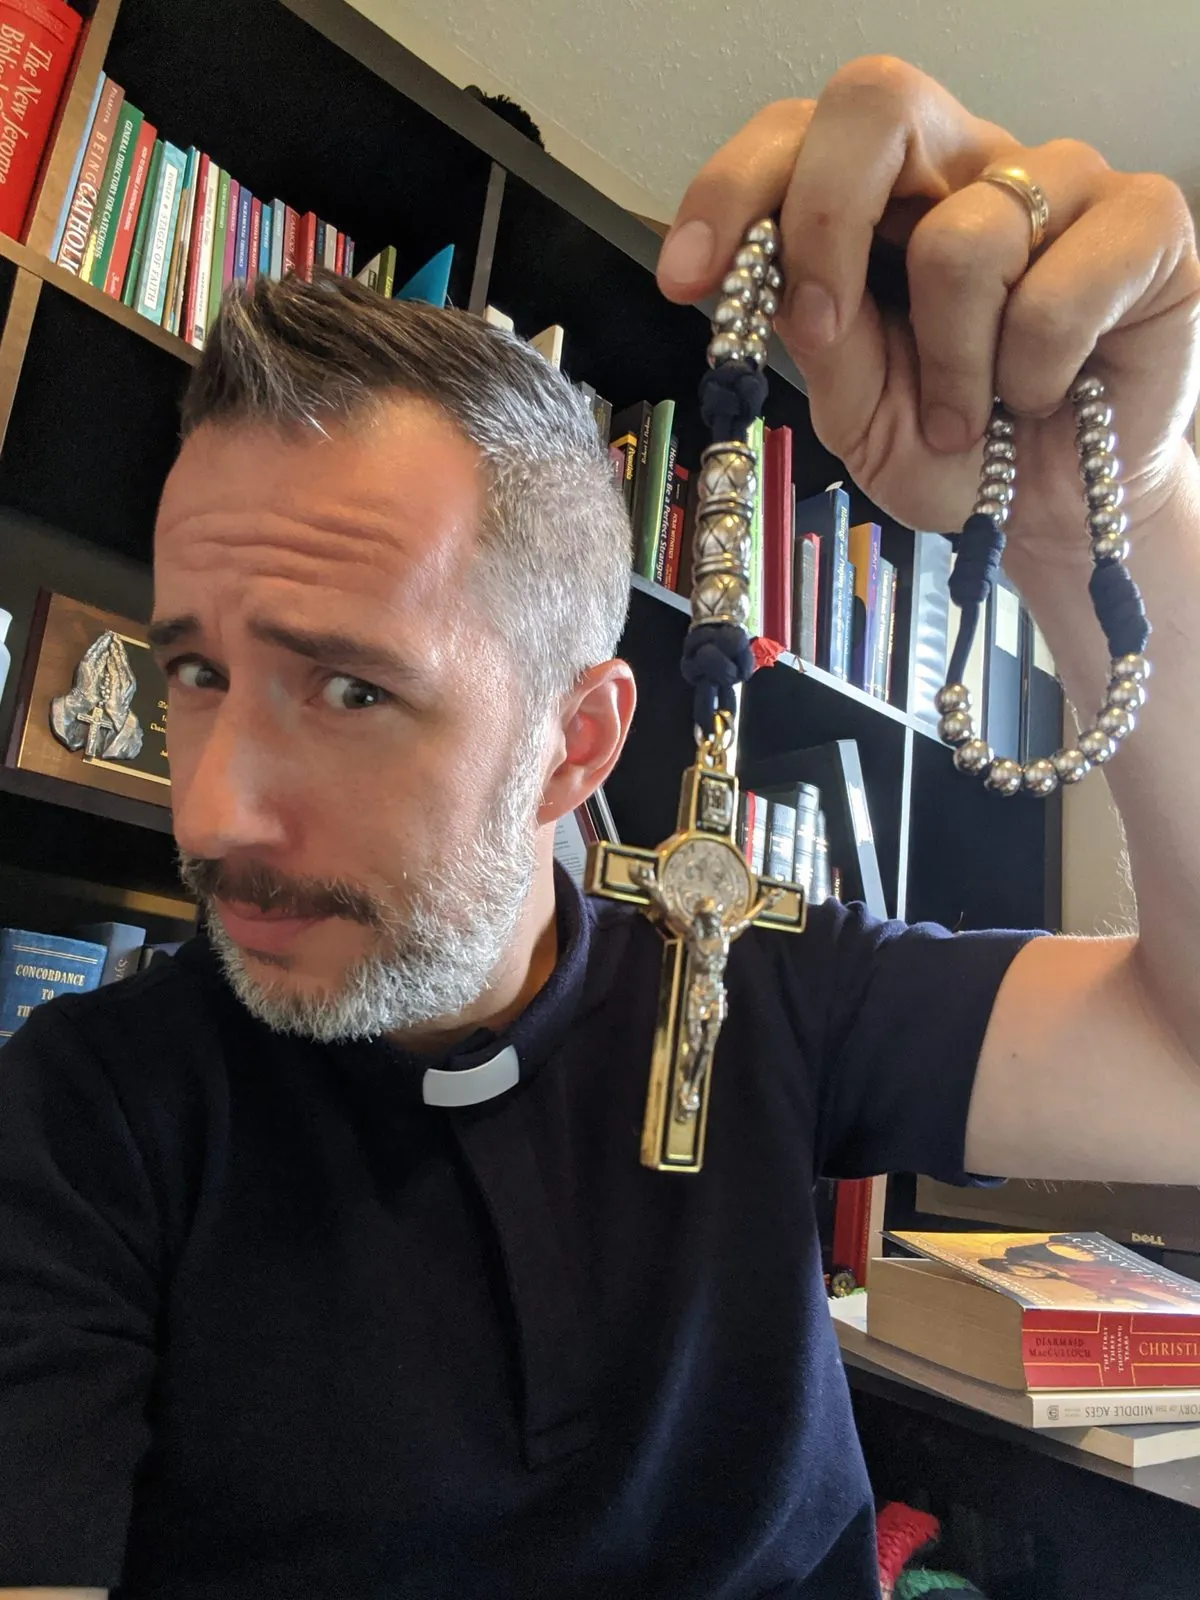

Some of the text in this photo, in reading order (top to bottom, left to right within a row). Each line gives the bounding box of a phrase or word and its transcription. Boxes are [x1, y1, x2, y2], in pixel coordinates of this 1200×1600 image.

[0, 42, 53, 184] The New Jerome
[85, 131, 107, 183] BEING
[95, 119, 133, 259] GENERAL DIRECTORY FOR CATECHESIS
[156, 213, 169, 250] STAGES
[152, 251, 162, 268] OF
[147, 267, 161, 302] FAITH
[669, 447, 677, 469] How
[666, 471, 674, 482] to
[665, 482, 673, 496] Be
[660, 503, 671, 539] Perfect
[655, 539, 668, 582] Stranger
[15, 964, 86, 986] CONCORDANCE
[41, 988, 55, 1000] TO
[16, 1004, 34, 1018] TH
[1131, 1232, 1165, 1246] DELL
[1139, 1341, 1198, 1356] CHRISTI
[1084, 1406, 1110, 1418] AGES
[1113, 1405, 1153, 1417] MIDDLE
[1179, 1404, 1200, 1416] ORY
